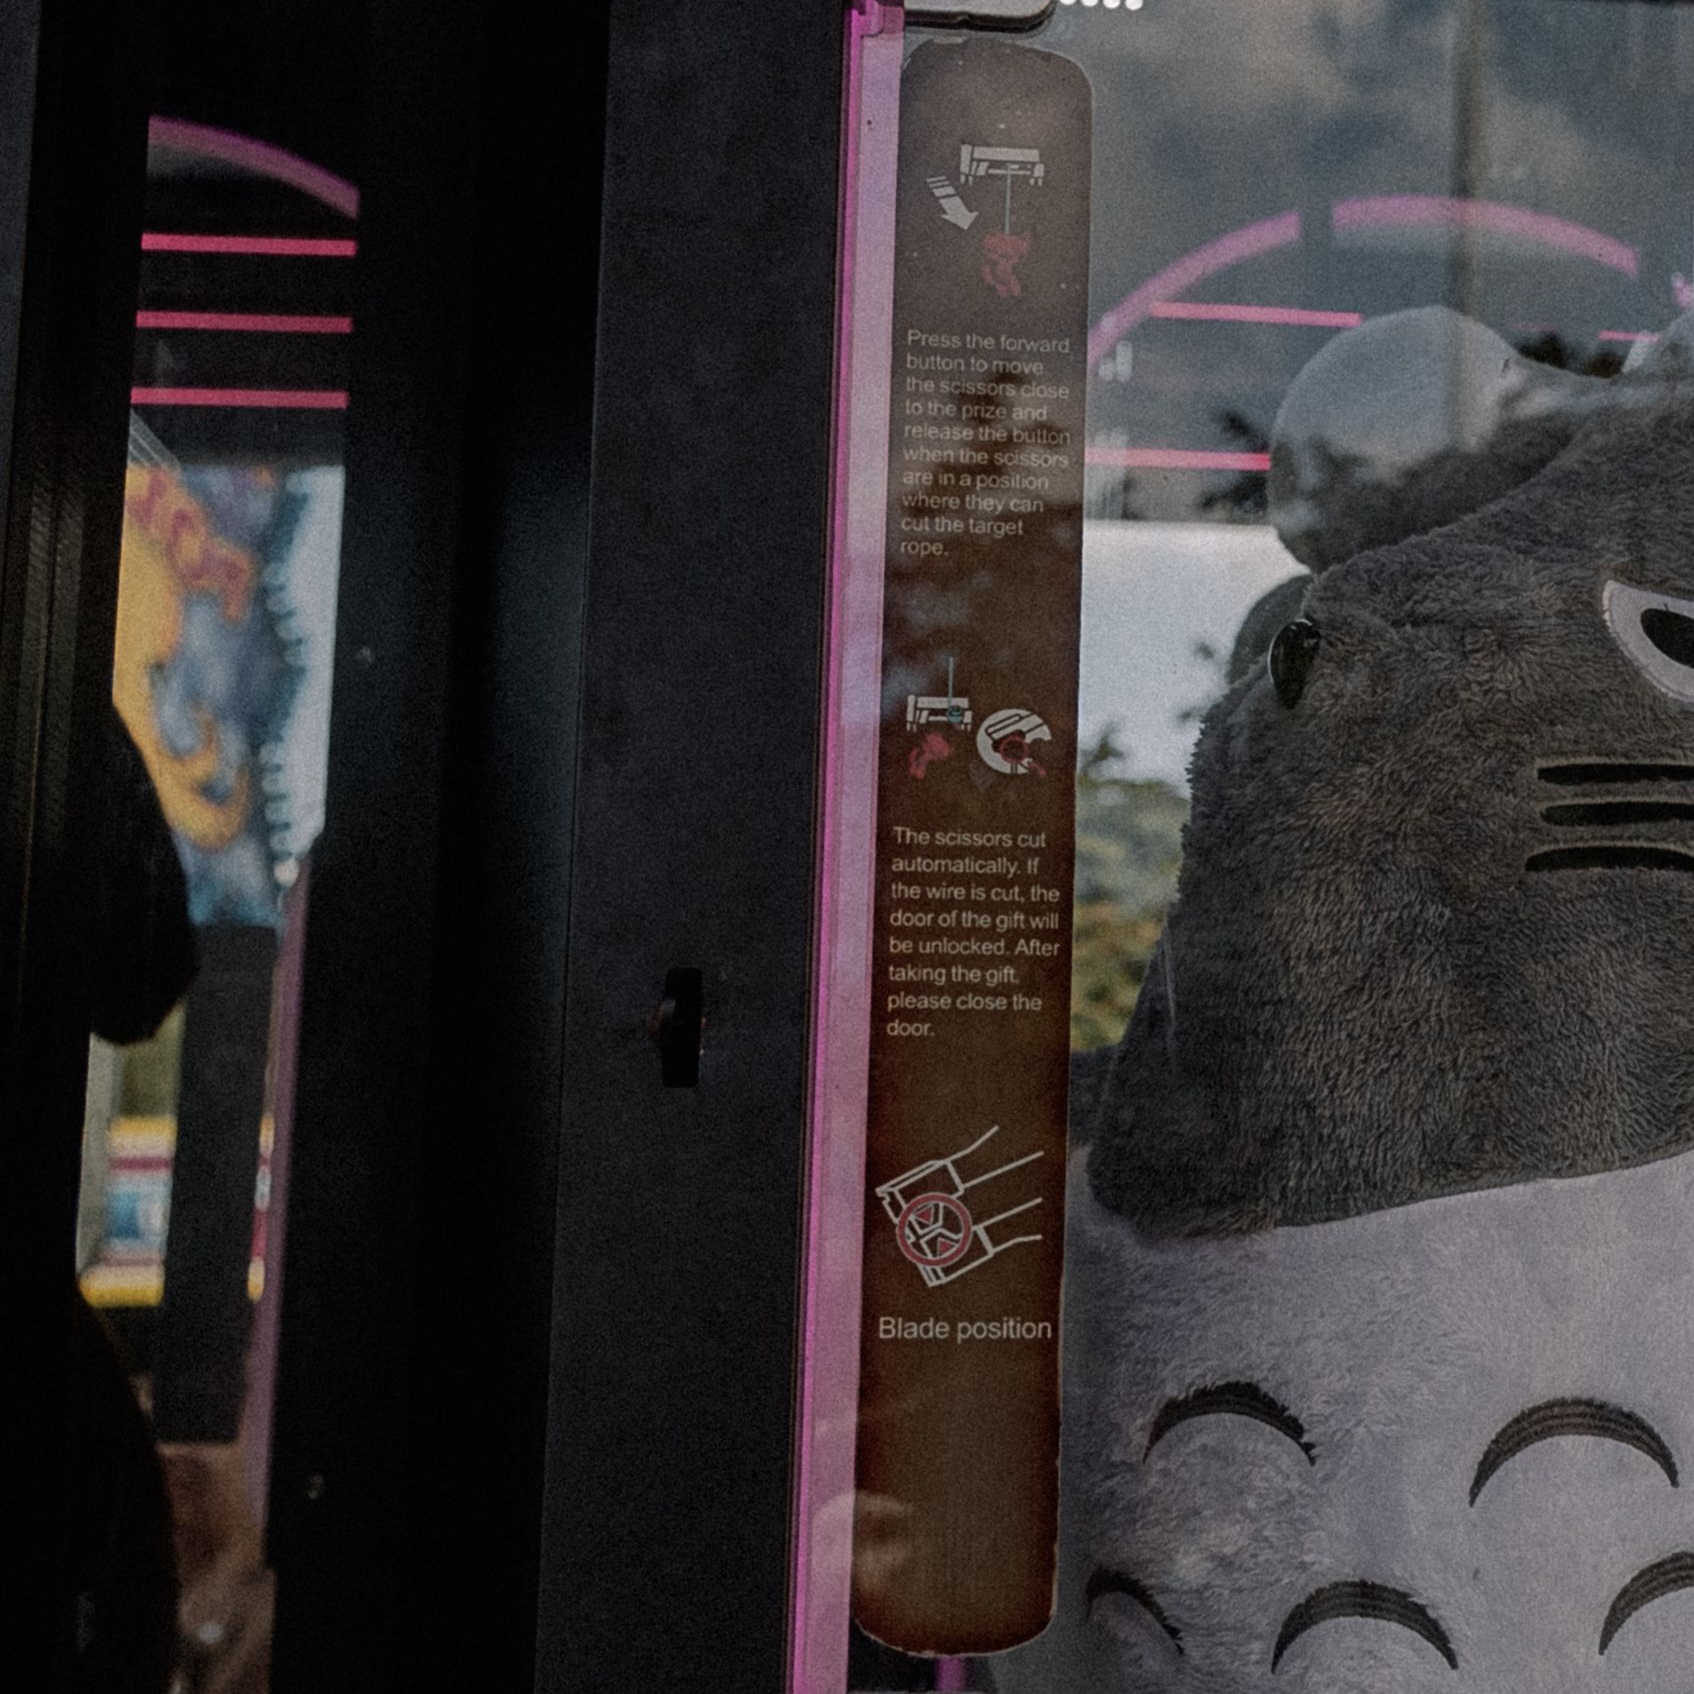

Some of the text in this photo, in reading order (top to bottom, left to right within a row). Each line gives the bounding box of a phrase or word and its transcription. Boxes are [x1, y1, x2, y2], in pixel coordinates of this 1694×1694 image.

[907, 329, 1070, 353] Press the forward
[906, 353, 1044, 375] button to move
[906, 376, 1070, 400] the scissors close
[905, 400, 1047, 421] to the prize and
[904, 423, 1071, 445] release the button
[904, 446, 1069, 468] when the scissors
[902, 471, 1049, 491] are in a position
[902, 491, 1044, 515] where they can
[901, 516, 1024, 539] cut the target
[900, 540, 948, 557] rope.
[893, 826, 1047, 848] The scissors cut
[891, 856, 1040, 879] automatically. If
[891, 881, 1061, 904] the wire is cut, the
[890, 909, 1060, 932] door of the gift will
[889, 936, 1060, 957] be unlocked. After
[889, 964, 946, 987] taking
[951, 965, 981, 983] the
[887, 991, 1043, 1012] please close the
[886, 1019, 935, 1037] door.
[879, 1316, 1052, 1345] Blade position
